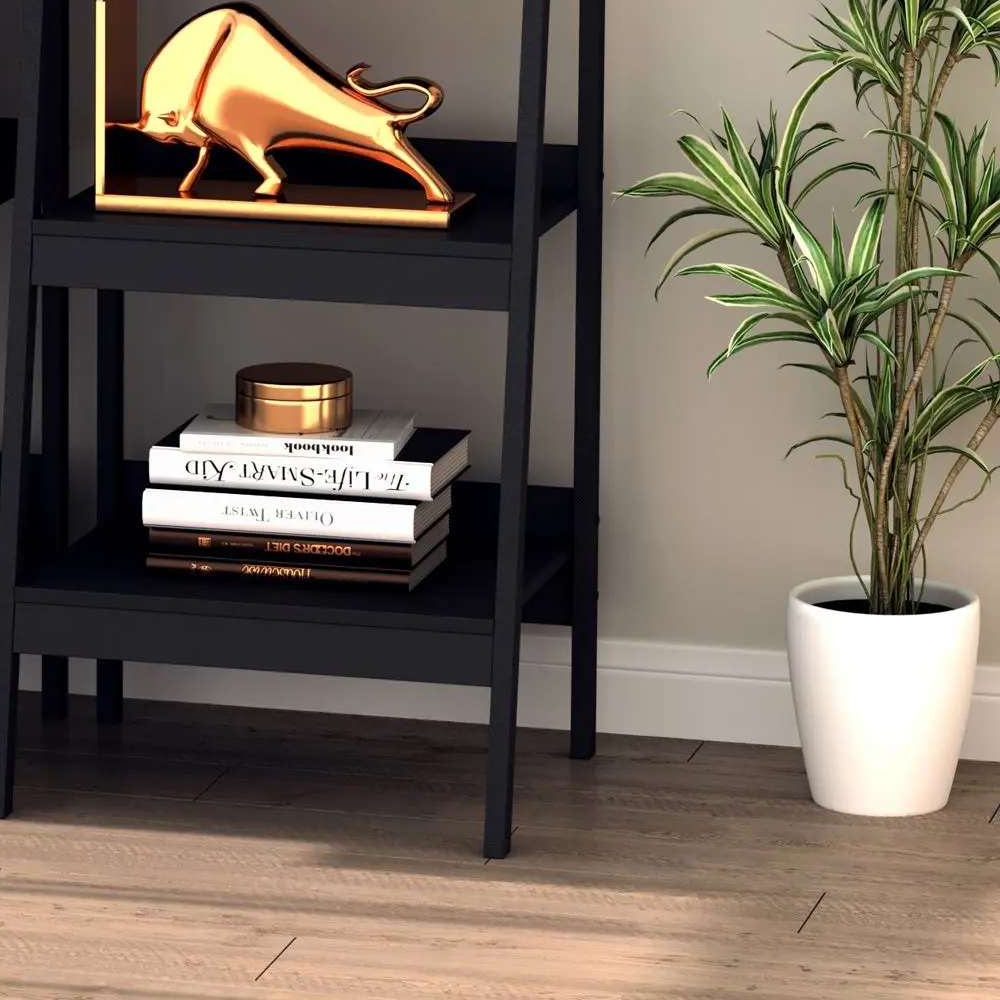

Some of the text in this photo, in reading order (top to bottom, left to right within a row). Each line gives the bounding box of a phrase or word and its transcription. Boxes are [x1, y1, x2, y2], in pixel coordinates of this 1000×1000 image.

[284, 442, 354, 456] lookbook
[222, 505, 334, 526] OLIVER TWIST
[265, 541, 291, 553] DIET
